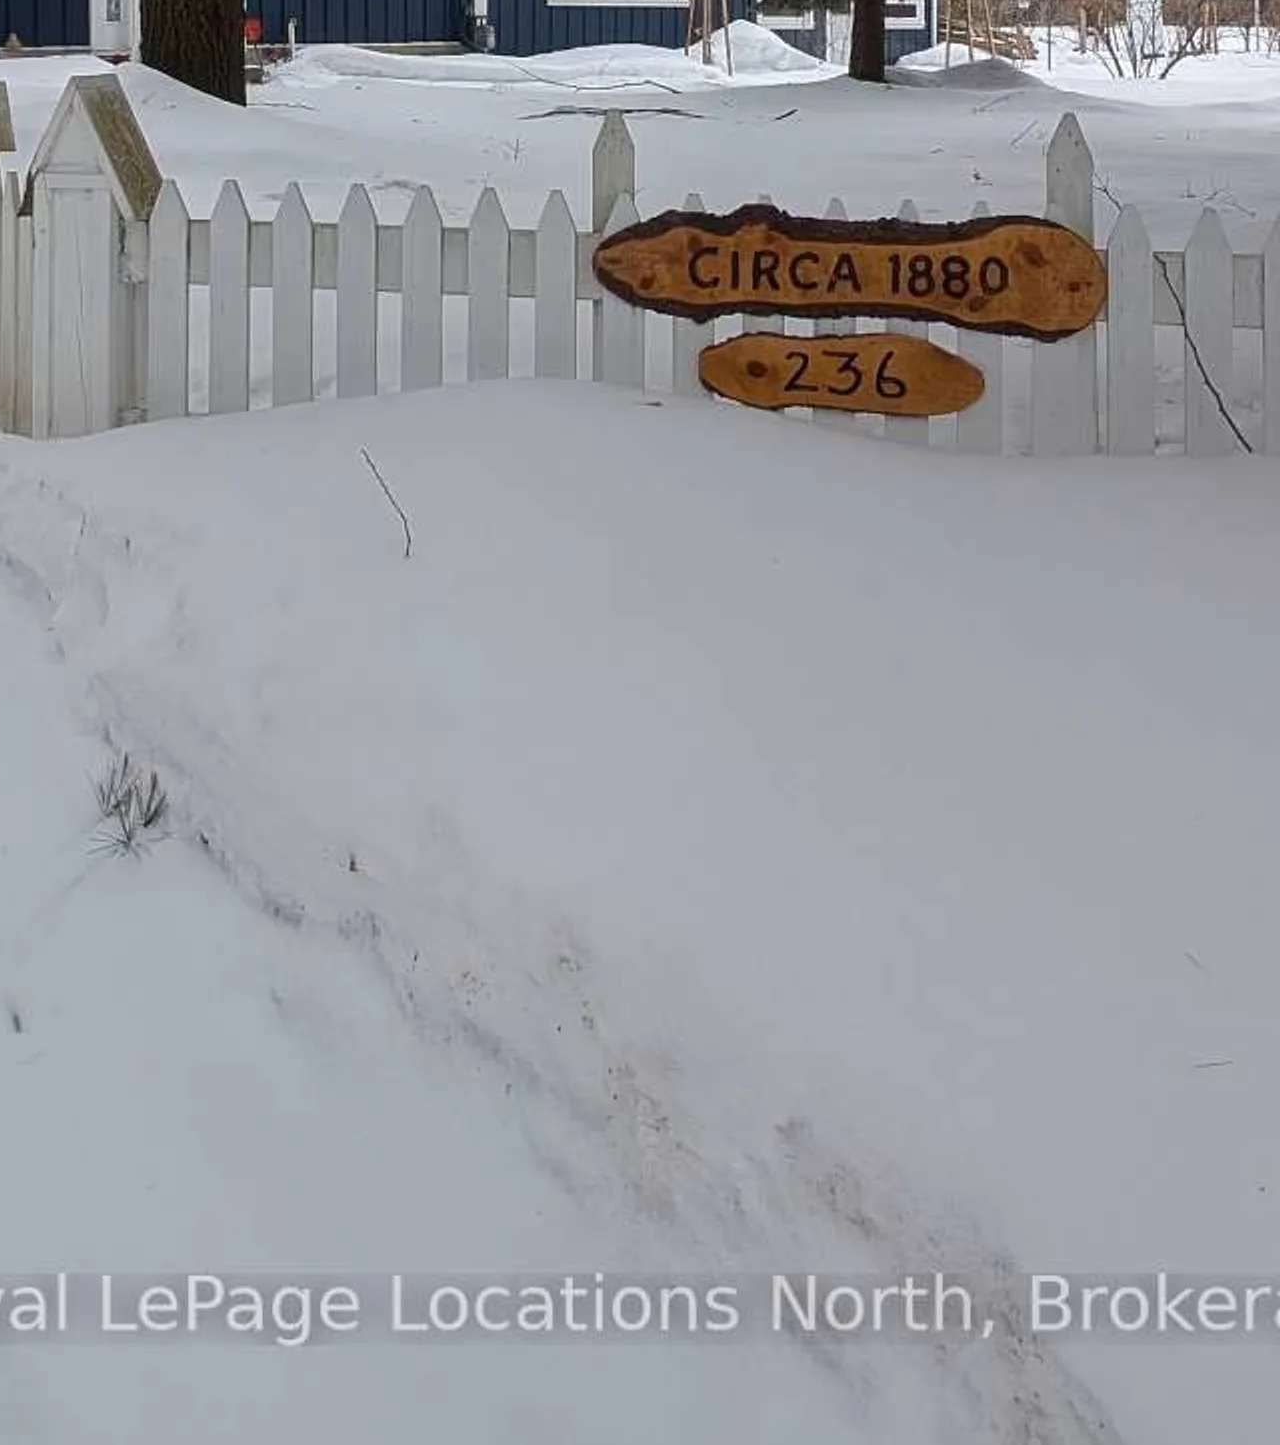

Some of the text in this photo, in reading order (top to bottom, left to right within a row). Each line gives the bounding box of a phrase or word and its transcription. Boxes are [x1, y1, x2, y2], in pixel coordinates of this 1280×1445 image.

[688, 246, 1010, 300] CIRCA 1880
[783, 351, 908, 399] 236
